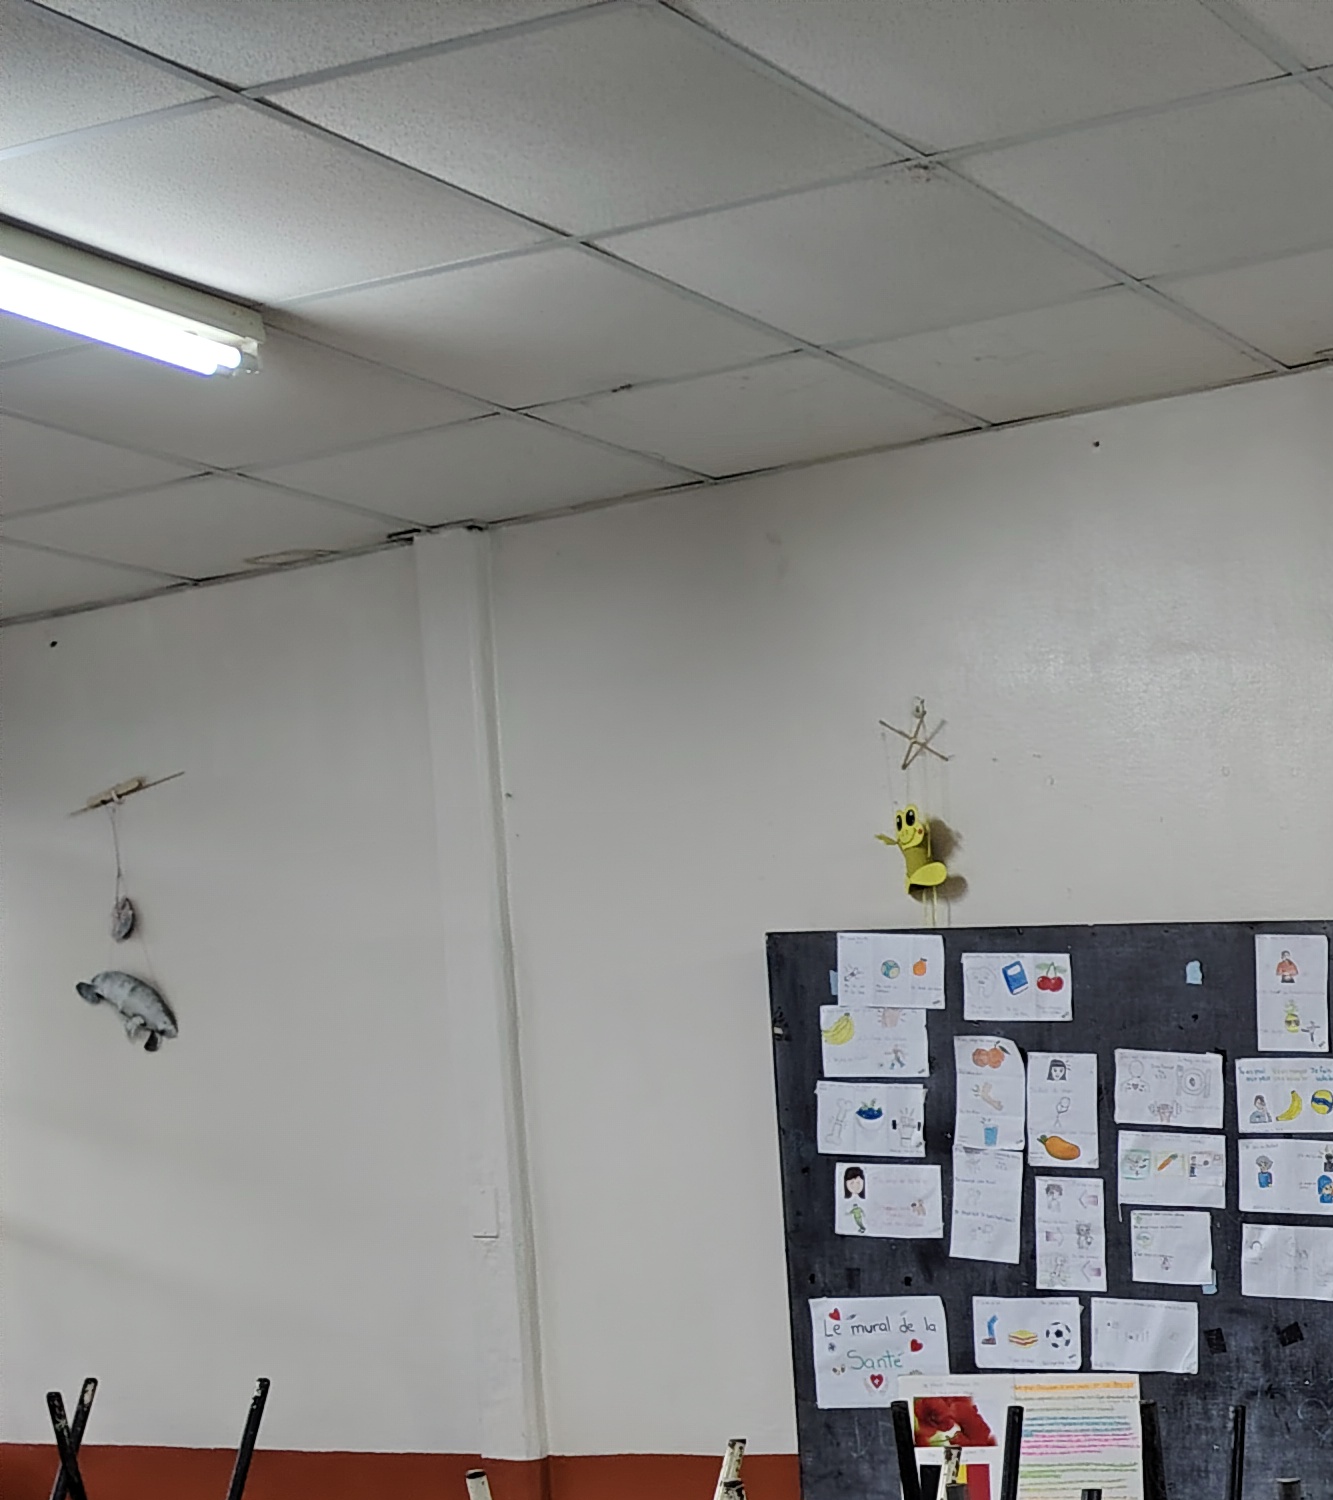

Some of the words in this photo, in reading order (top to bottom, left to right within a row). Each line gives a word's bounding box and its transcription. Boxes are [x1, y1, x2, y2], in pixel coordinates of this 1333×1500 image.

[824, 1319, 842, 1338] Le
[850, 1316, 892, 1336] mural
[899, 1317, 915, 1334] de
[923, 1316, 937, 1333] la
[846, 1350, 905, 1371] Santé
